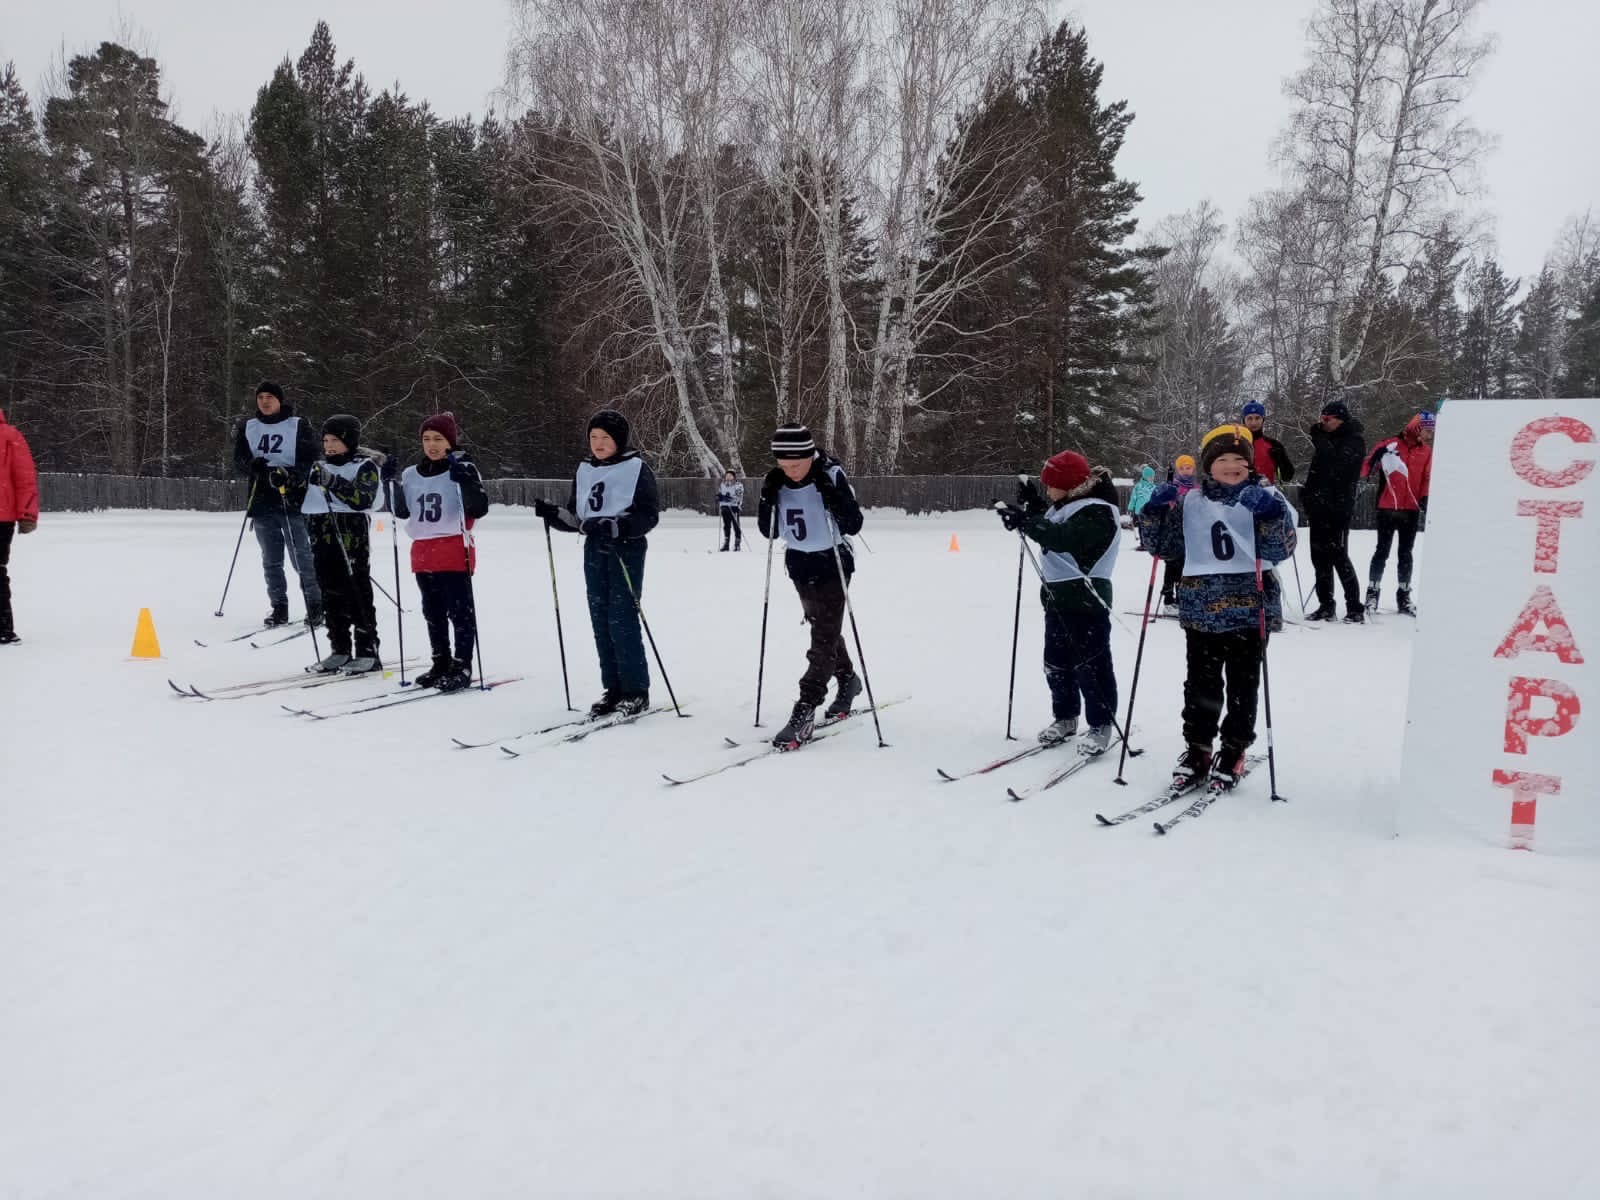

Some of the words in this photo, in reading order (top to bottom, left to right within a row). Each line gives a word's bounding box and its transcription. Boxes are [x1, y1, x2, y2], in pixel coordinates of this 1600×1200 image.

[257, 434, 283, 453] 42
[416, 493, 442, 522] 13
[589, 482, 605, 511] 3
[786, 509, 807, 541] 5
[1211, 520, 1235, 561] 6
[1493, 416, 1597, 850] СТАРТ
